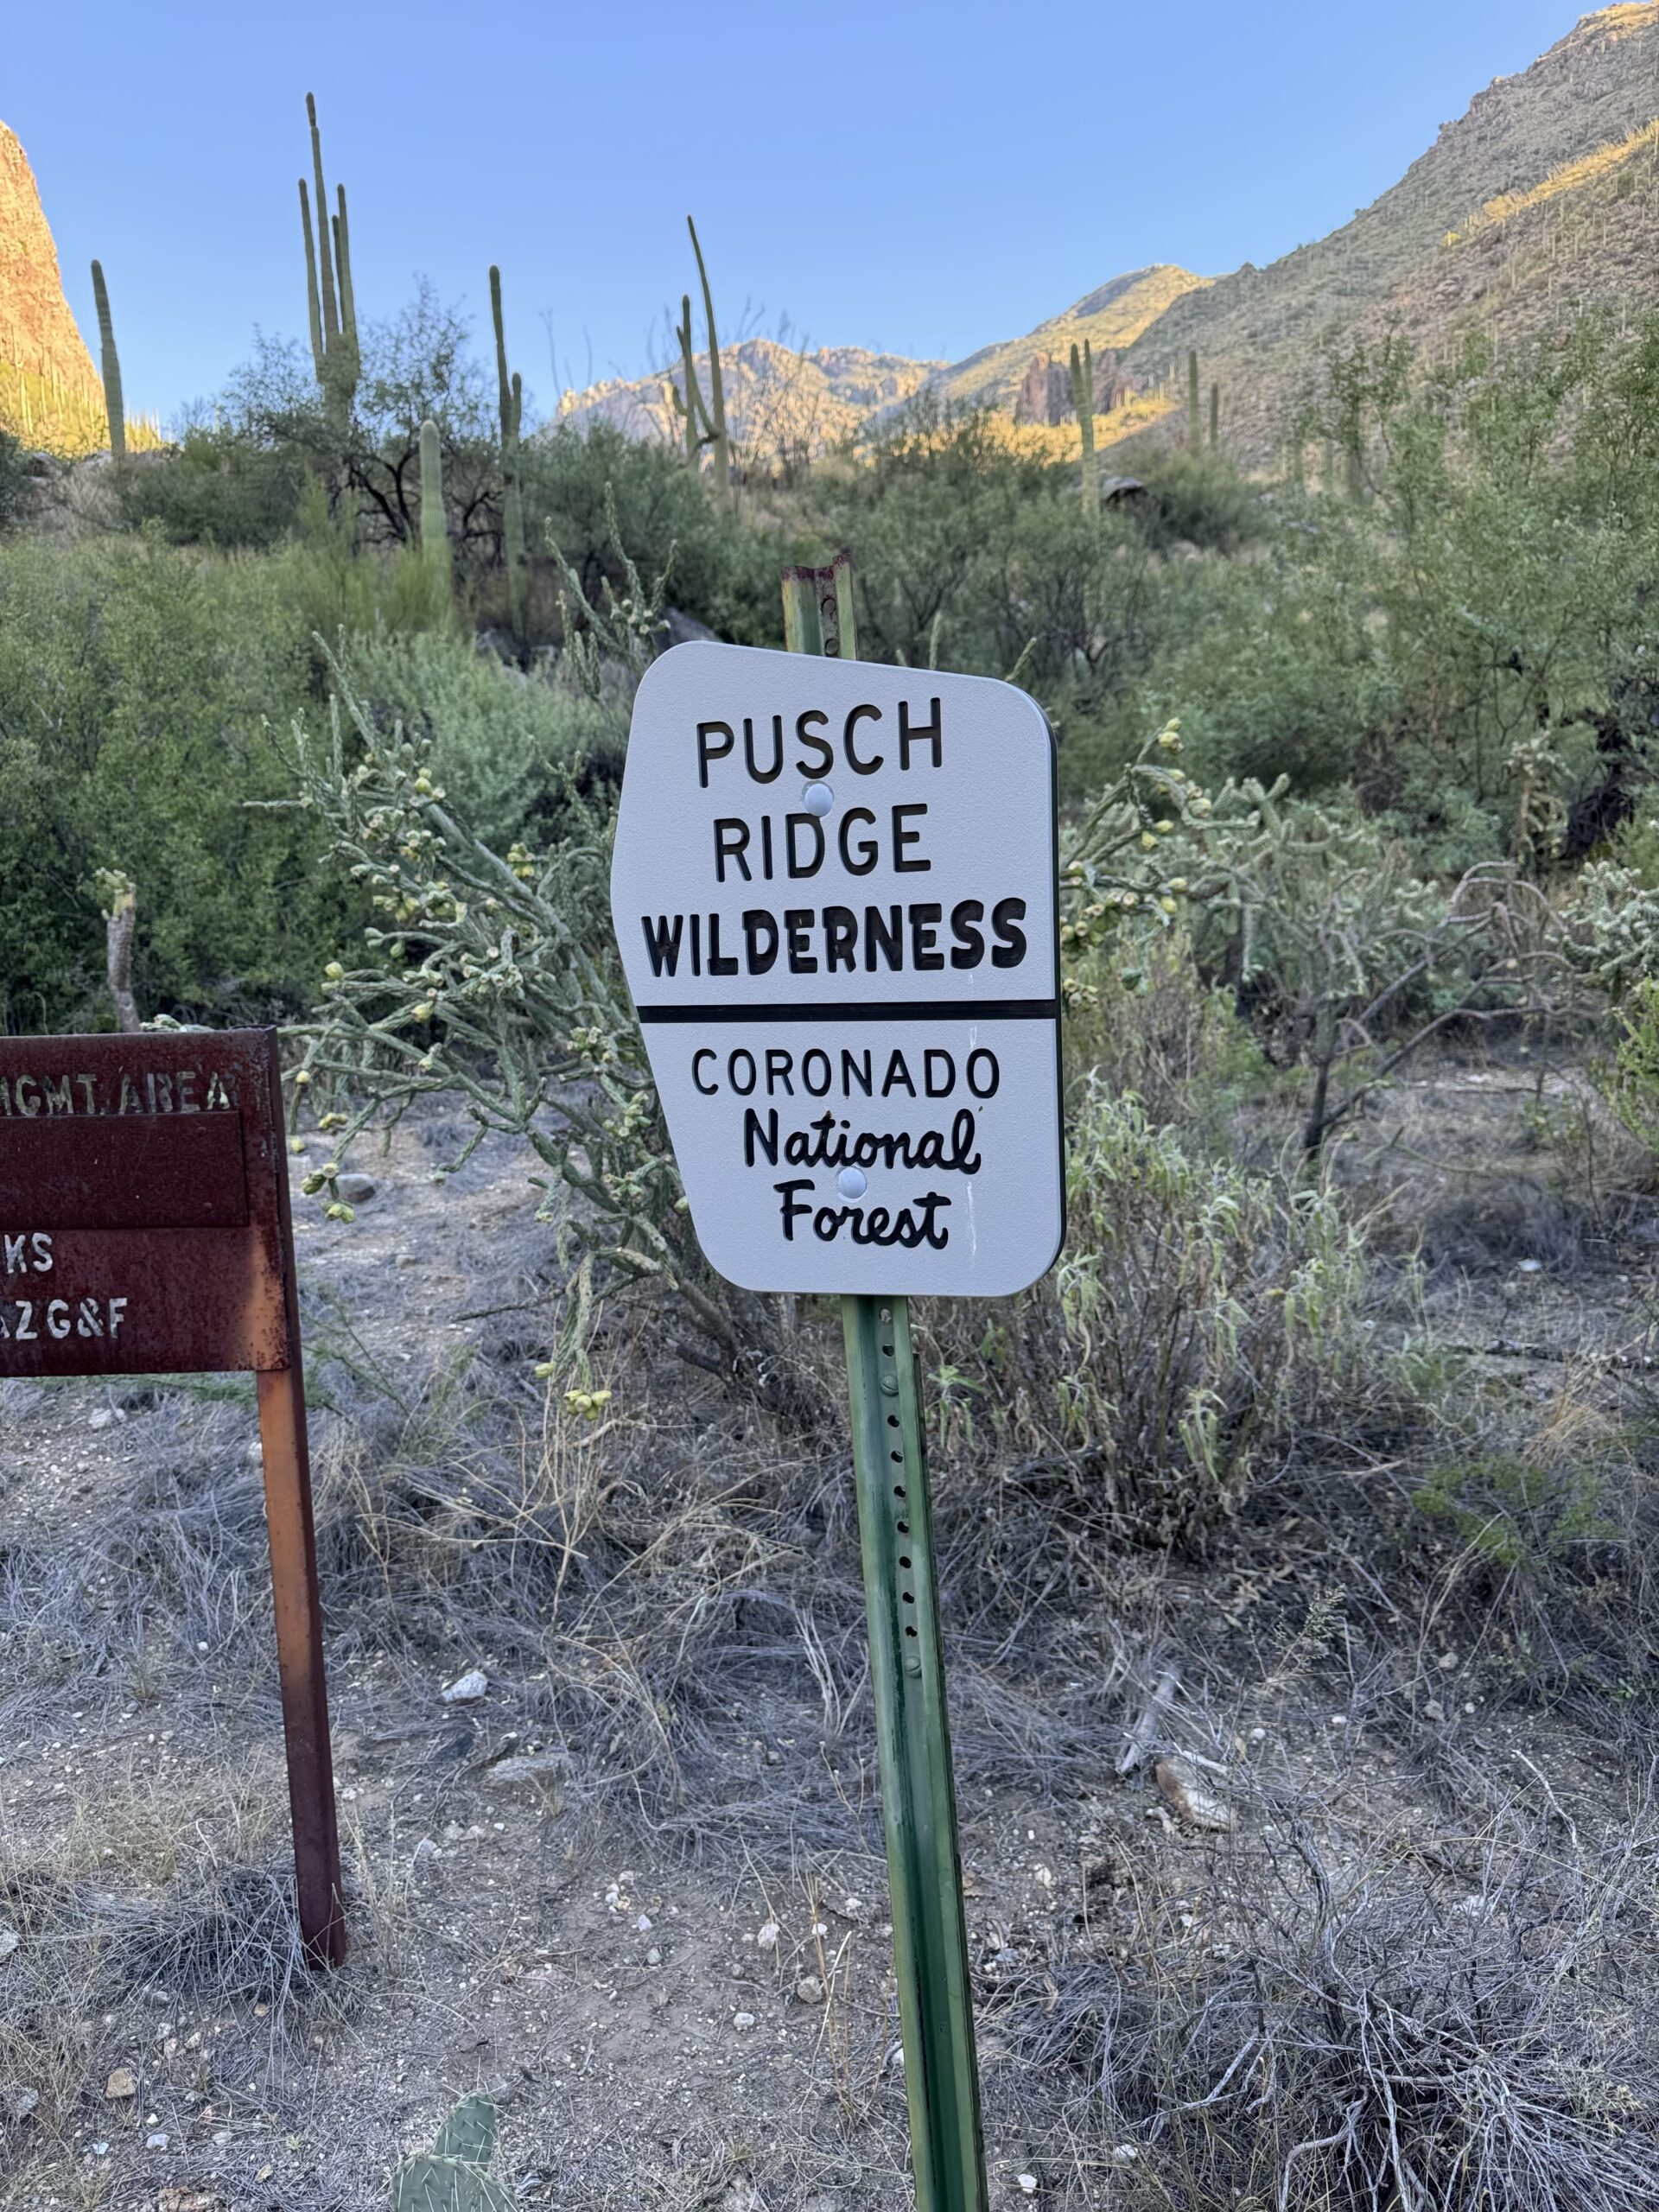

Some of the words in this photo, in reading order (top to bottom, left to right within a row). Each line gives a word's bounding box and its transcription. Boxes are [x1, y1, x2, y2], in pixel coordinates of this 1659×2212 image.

[696, 697, 943, 788] PUSCH
[714, 803, 931, 882] RIDGE
[641, 897, 1027, 977] WILDERNESS
[118, 1071, 231, 1115] AREA
[691, 1048, 1001, 1099] CORONADO
[744, 1108, 982, 1174] National
[773, 1179, 952, 1250] Forest
[47, 1297, 128, 1339] G&F
